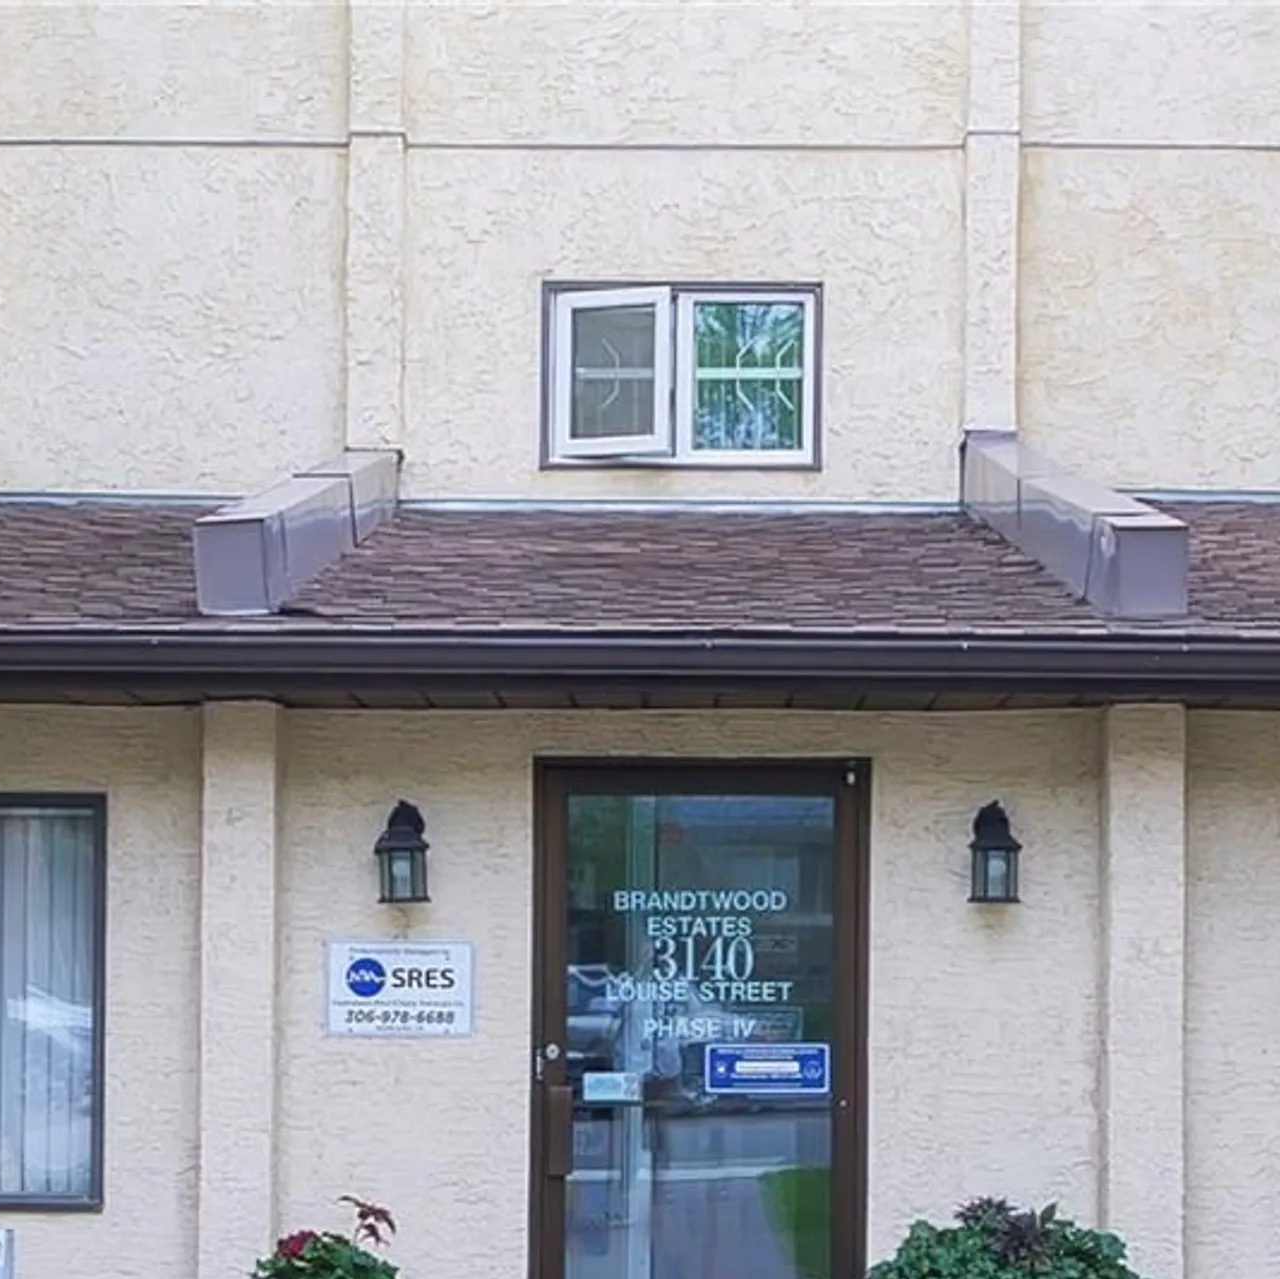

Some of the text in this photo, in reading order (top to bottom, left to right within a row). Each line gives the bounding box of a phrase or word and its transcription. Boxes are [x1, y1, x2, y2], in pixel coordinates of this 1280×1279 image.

[613, 889, 788, 912] BRANDTWOOD
[647, 916, 752, 937] ESTATES
[653, 936, 754, 981] 3140
[391, 967, 455, 989] SRES
[605, 981, 793, 1002] LOUISE STREET
[643, 1018, 720, 1039] PHASE
[733, 1018, 756, 1038] IV
